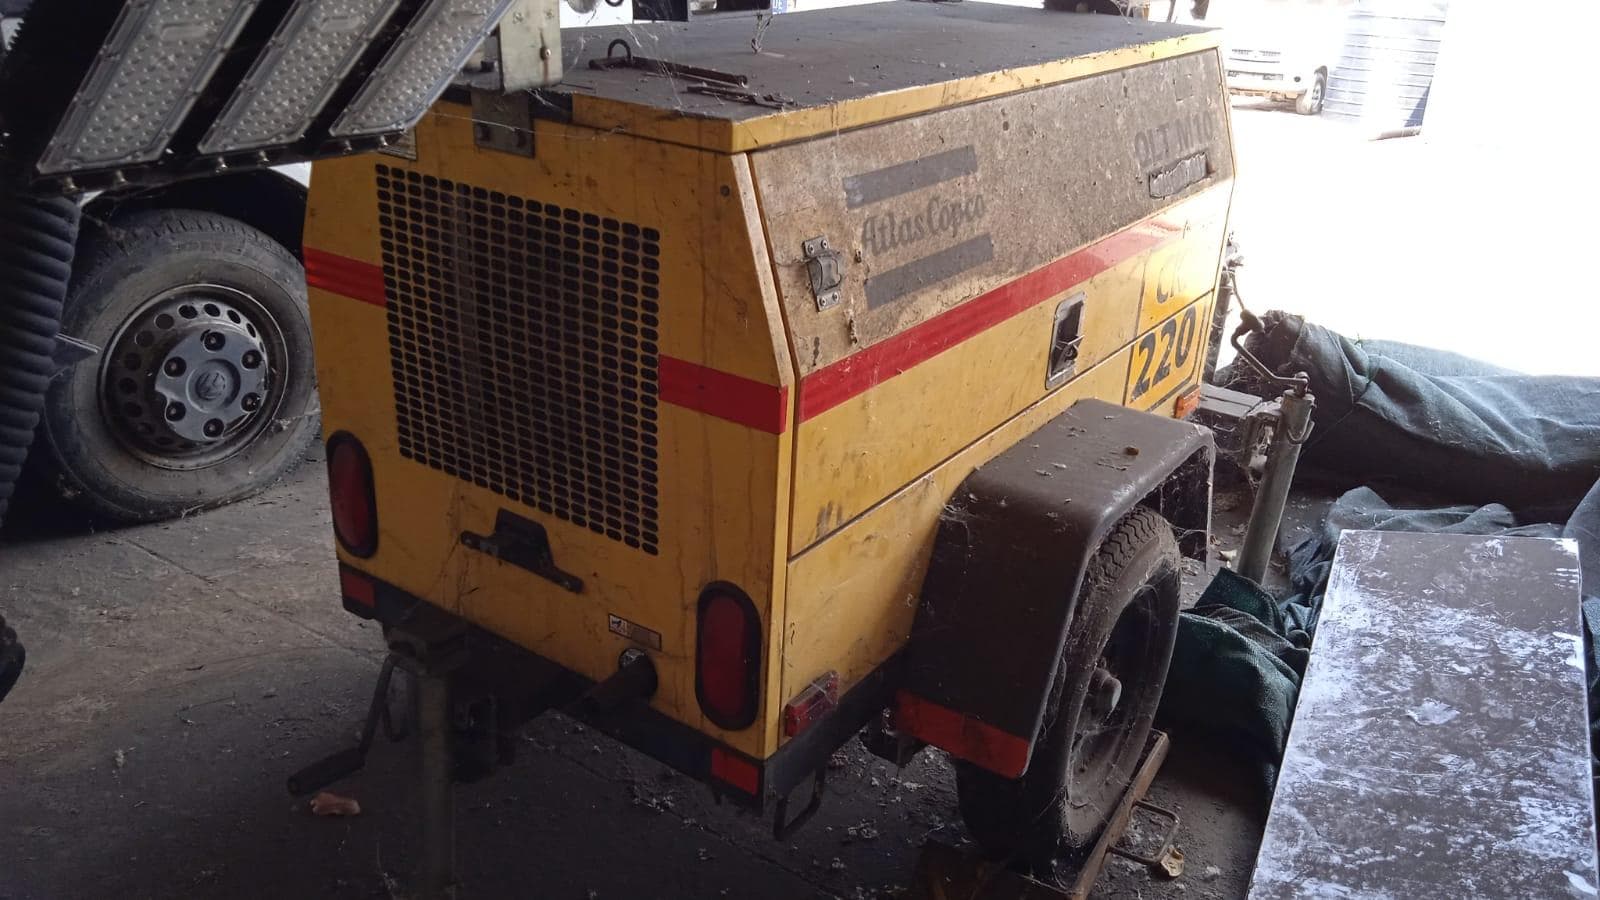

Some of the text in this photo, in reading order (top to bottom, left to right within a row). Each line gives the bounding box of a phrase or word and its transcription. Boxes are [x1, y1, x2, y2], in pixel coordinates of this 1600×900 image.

[862, 194, 986, 257] Atlas Copco
[1130, 305, 1197, 402] 220
